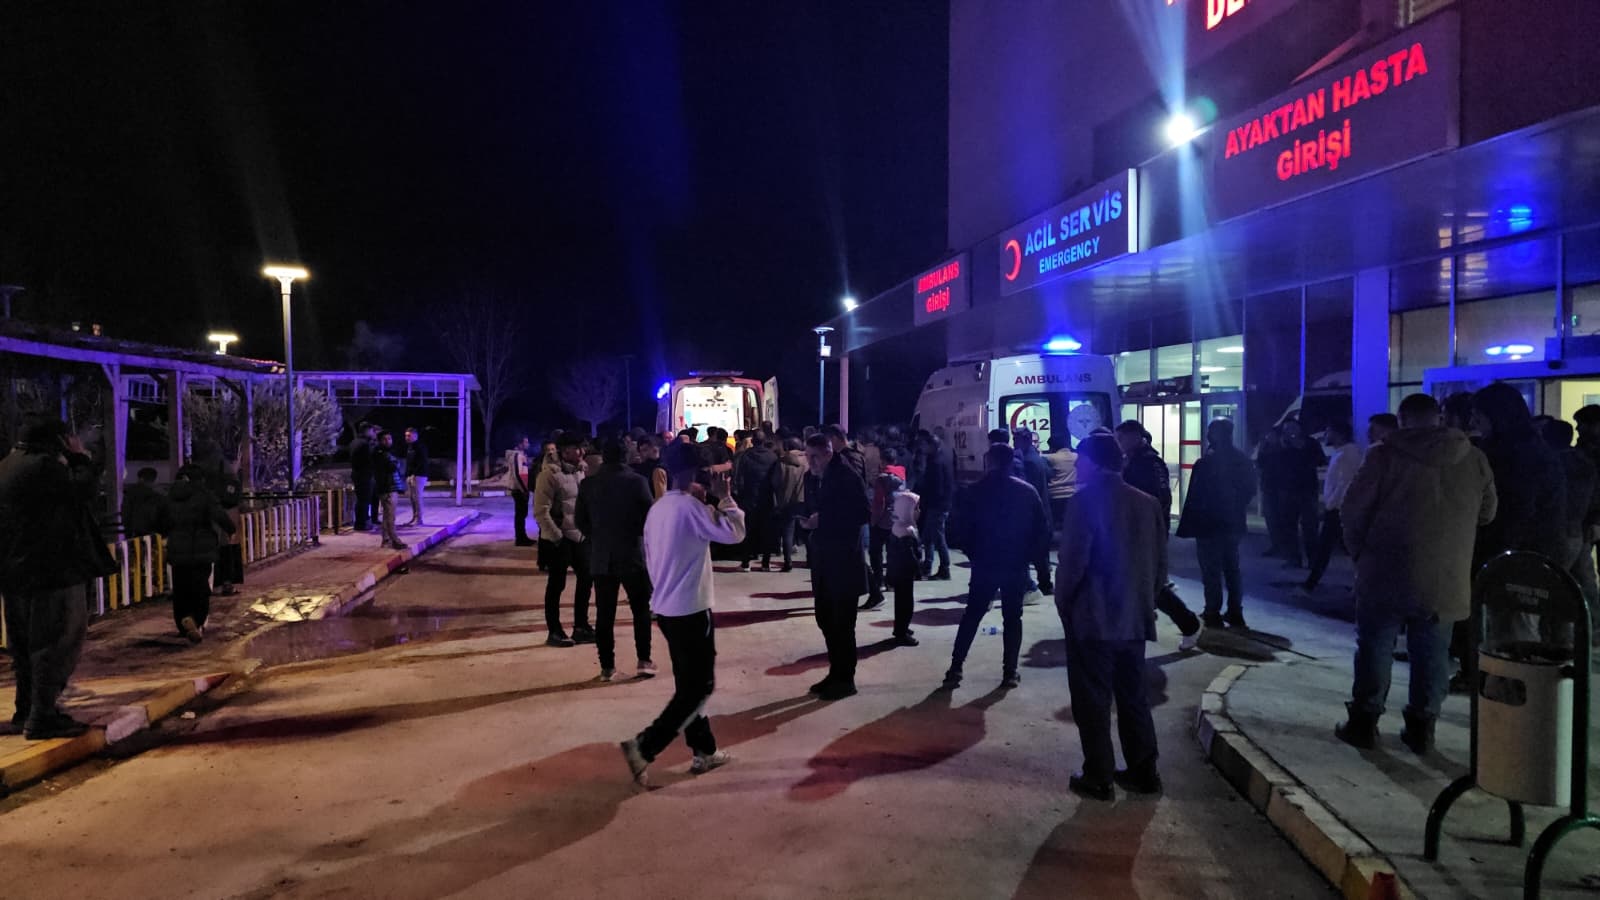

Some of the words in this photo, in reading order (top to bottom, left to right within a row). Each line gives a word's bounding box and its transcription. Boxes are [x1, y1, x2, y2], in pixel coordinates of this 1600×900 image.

[1225, 89, 1325, 159] AYAKTAN
[1332, 42, 1428, 113] HASTA
[1276, 119, 1351, 181] GİRİŞİ
[1025, 220, 1056, 256] ACİL
[1060, 190, 1122, 241] SERVİS
[1039, 237, 1100, 274] EMERGENCY
[918, 261, 960, 293] AMBULANS
[1014, 373, 1092, 385] AMBULANS
[953, 431, 967, 449] 112
[1019, 418, 1050, 431] 112
